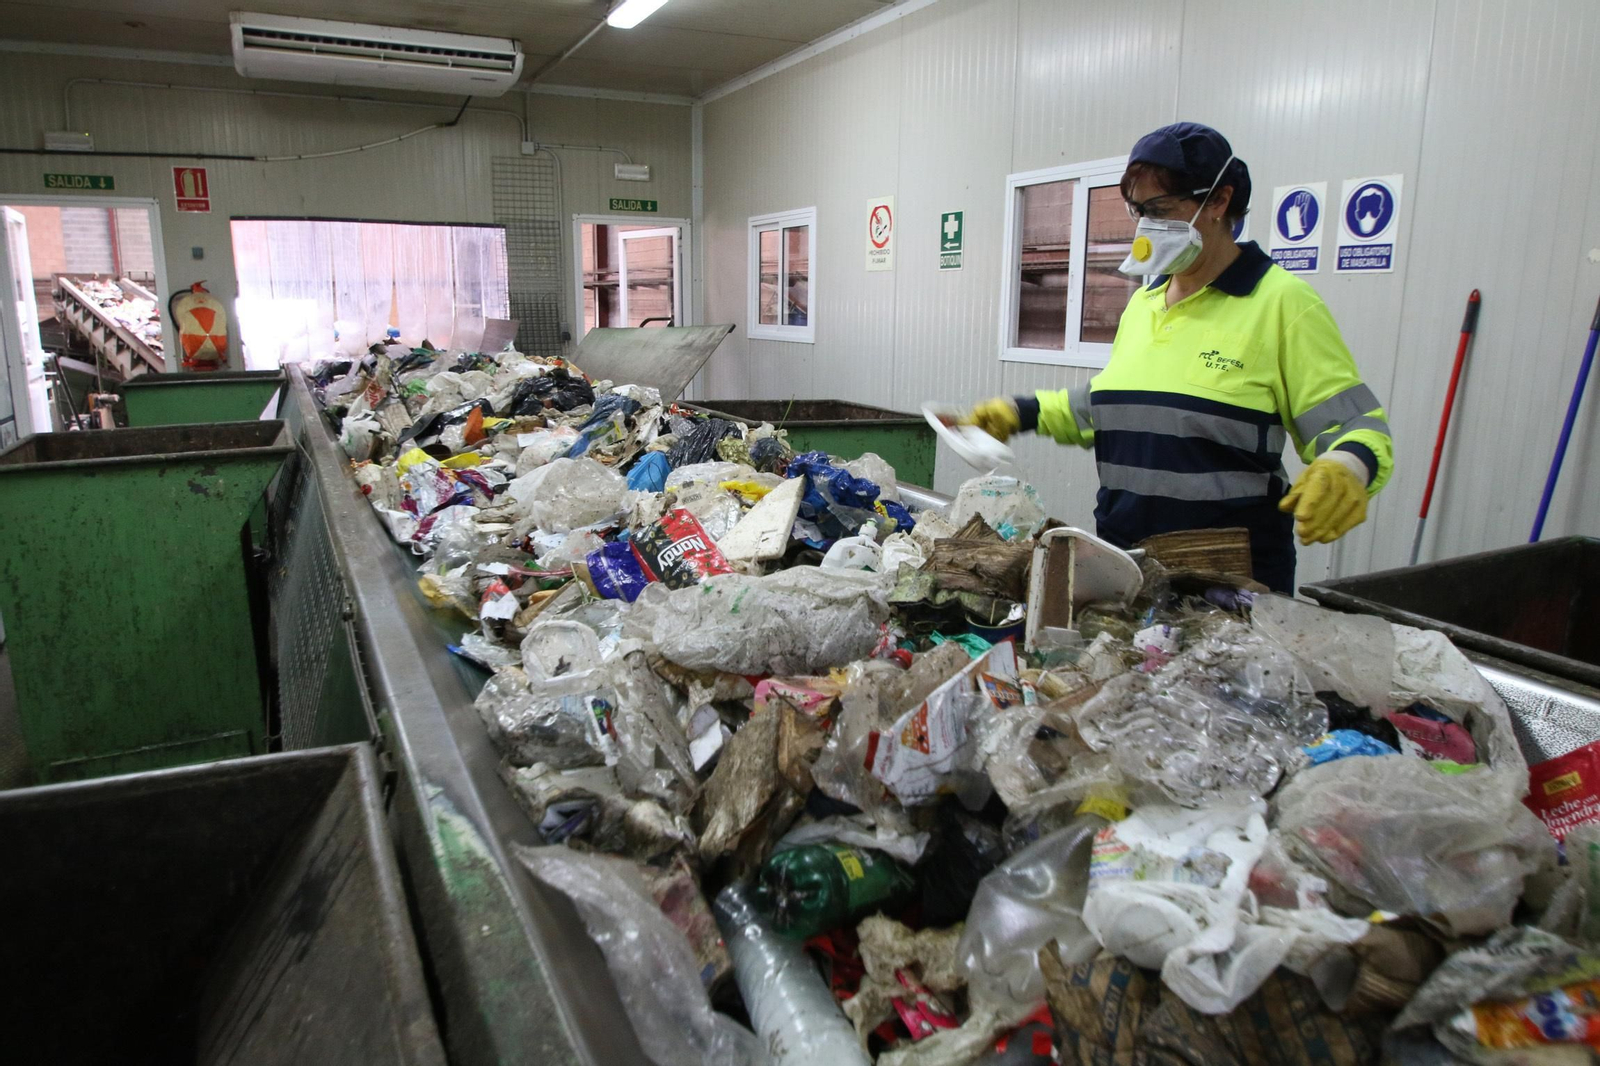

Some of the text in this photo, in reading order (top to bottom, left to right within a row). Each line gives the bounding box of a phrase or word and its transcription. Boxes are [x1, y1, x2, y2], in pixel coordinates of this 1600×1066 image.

[47, 175, 92, 188] SALIDA
[612, 199, 643, 211] SALIDA
[1272, 249, 1317, 260] USO OBLIGATORIO
[1339, 246, 1391, 258] USO OBLIGATORIO
[1285, 260, 1310, 269] GUANTES
[1341, 257, 1387, 268] DE MASCARILLA
[1205, 361, 1229, 372] U.T.E.
[657, 535, 708, 572] Nandy
[1540, 799, 1581, 819] Leche
[1546, 803, 1600, 829] lmendra
